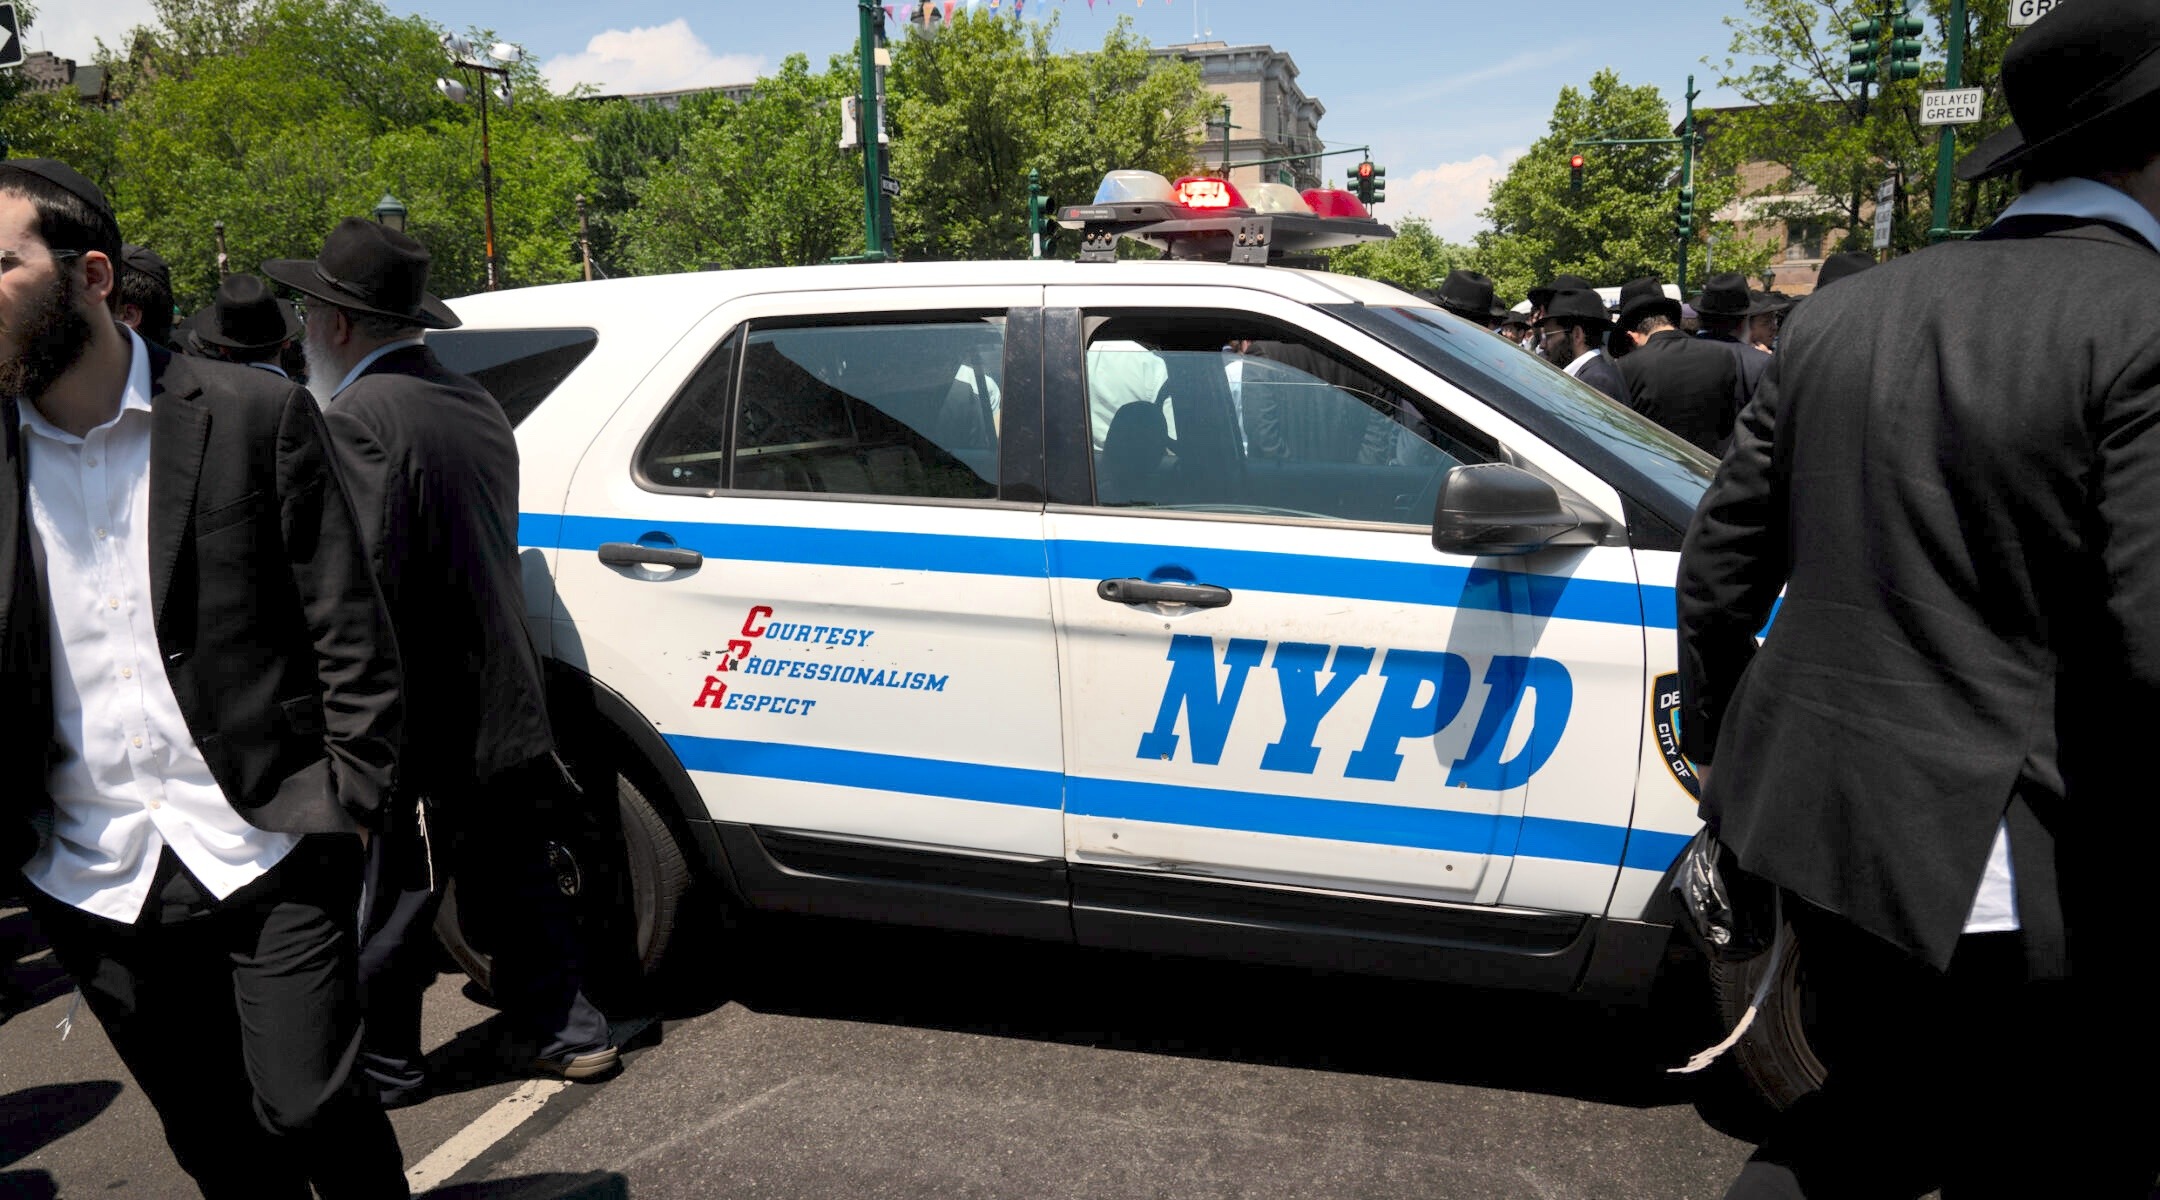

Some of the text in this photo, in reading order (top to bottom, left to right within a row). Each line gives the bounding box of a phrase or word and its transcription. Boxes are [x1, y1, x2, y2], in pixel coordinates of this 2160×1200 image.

[2020, 0, 2061, 17] GR
[1926, 93, 1977, 107] DELAYED
[1926, 107, 1975, 120] GREEN
[741, 605, 874, 648] COURTESY
[716, 639, 949, 692] PROFESSIONALISM
[693, 675, 816, 716] RESPECT
[1136, 634, 1573, 791] NYPD
[1658, 723, 1691, 777] CITY OF
